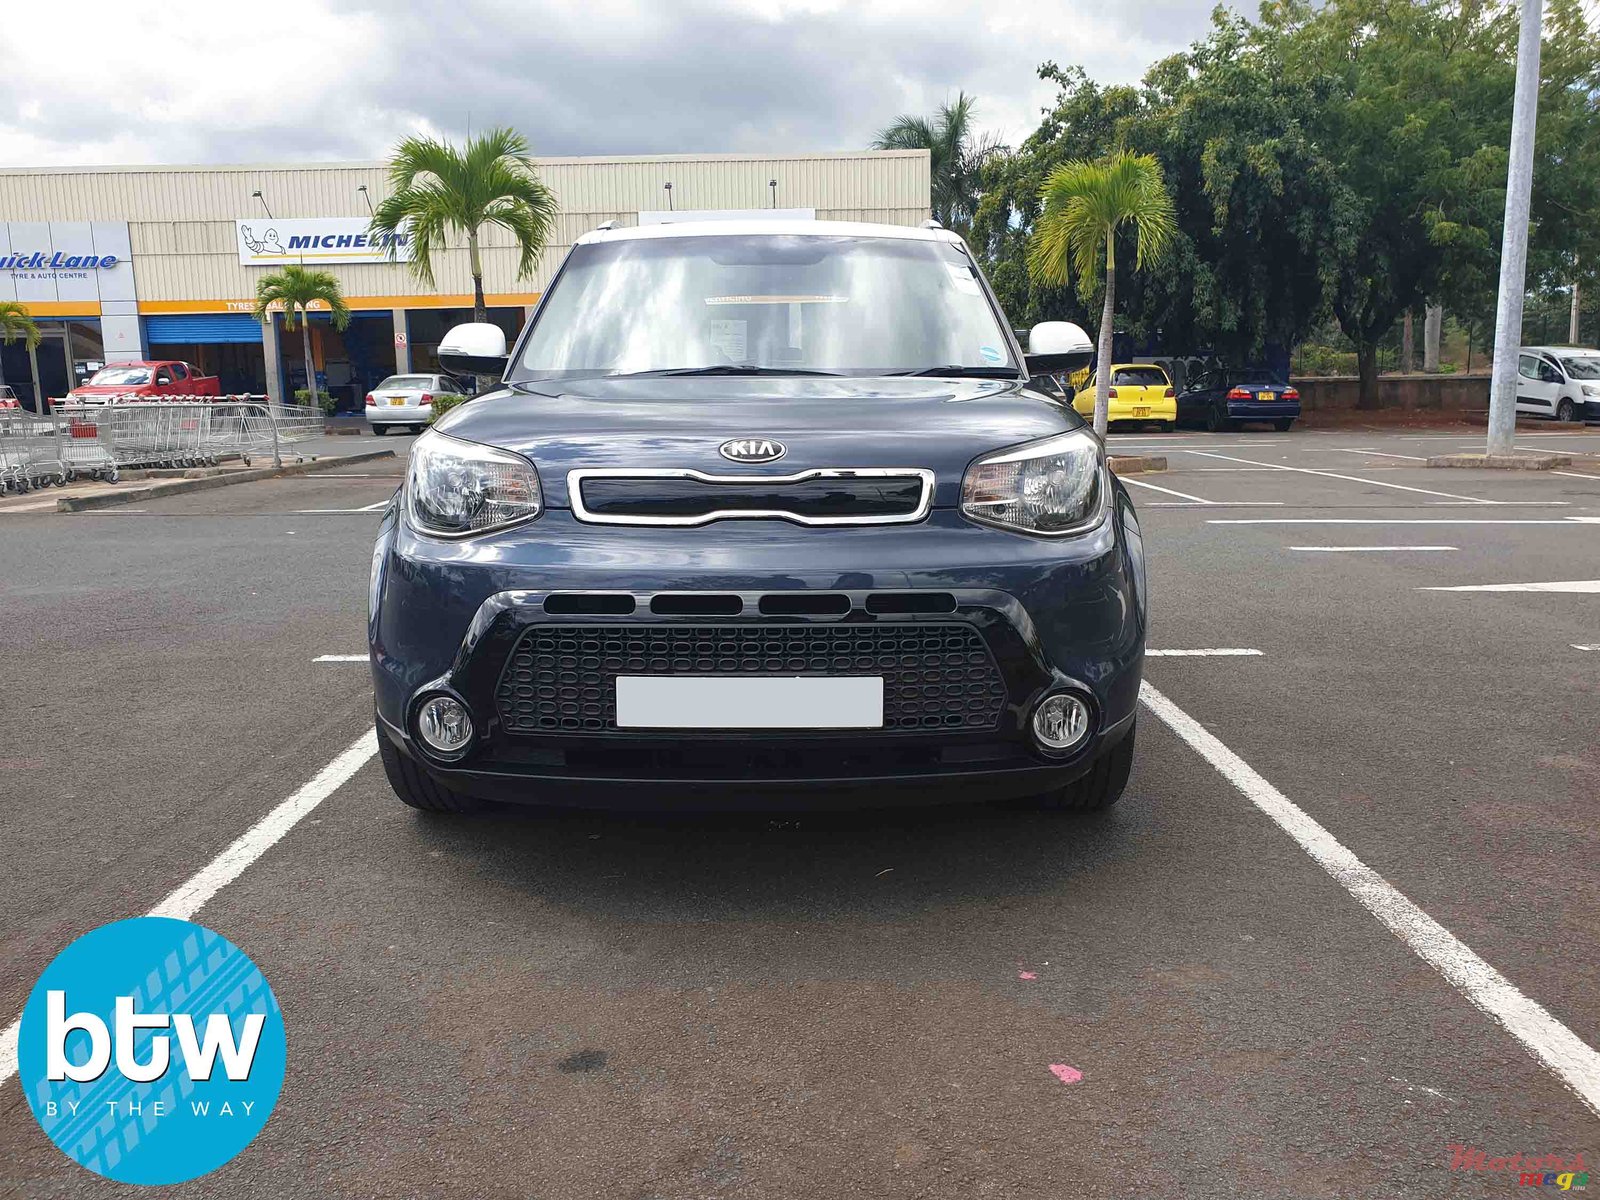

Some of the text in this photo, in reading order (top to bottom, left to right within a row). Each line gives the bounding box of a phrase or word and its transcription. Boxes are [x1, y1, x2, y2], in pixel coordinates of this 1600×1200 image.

[49, 251, 117, 269] Lane
[226, 302, 255, 311] TYRES
[731, 440, 775, 456] KIA
